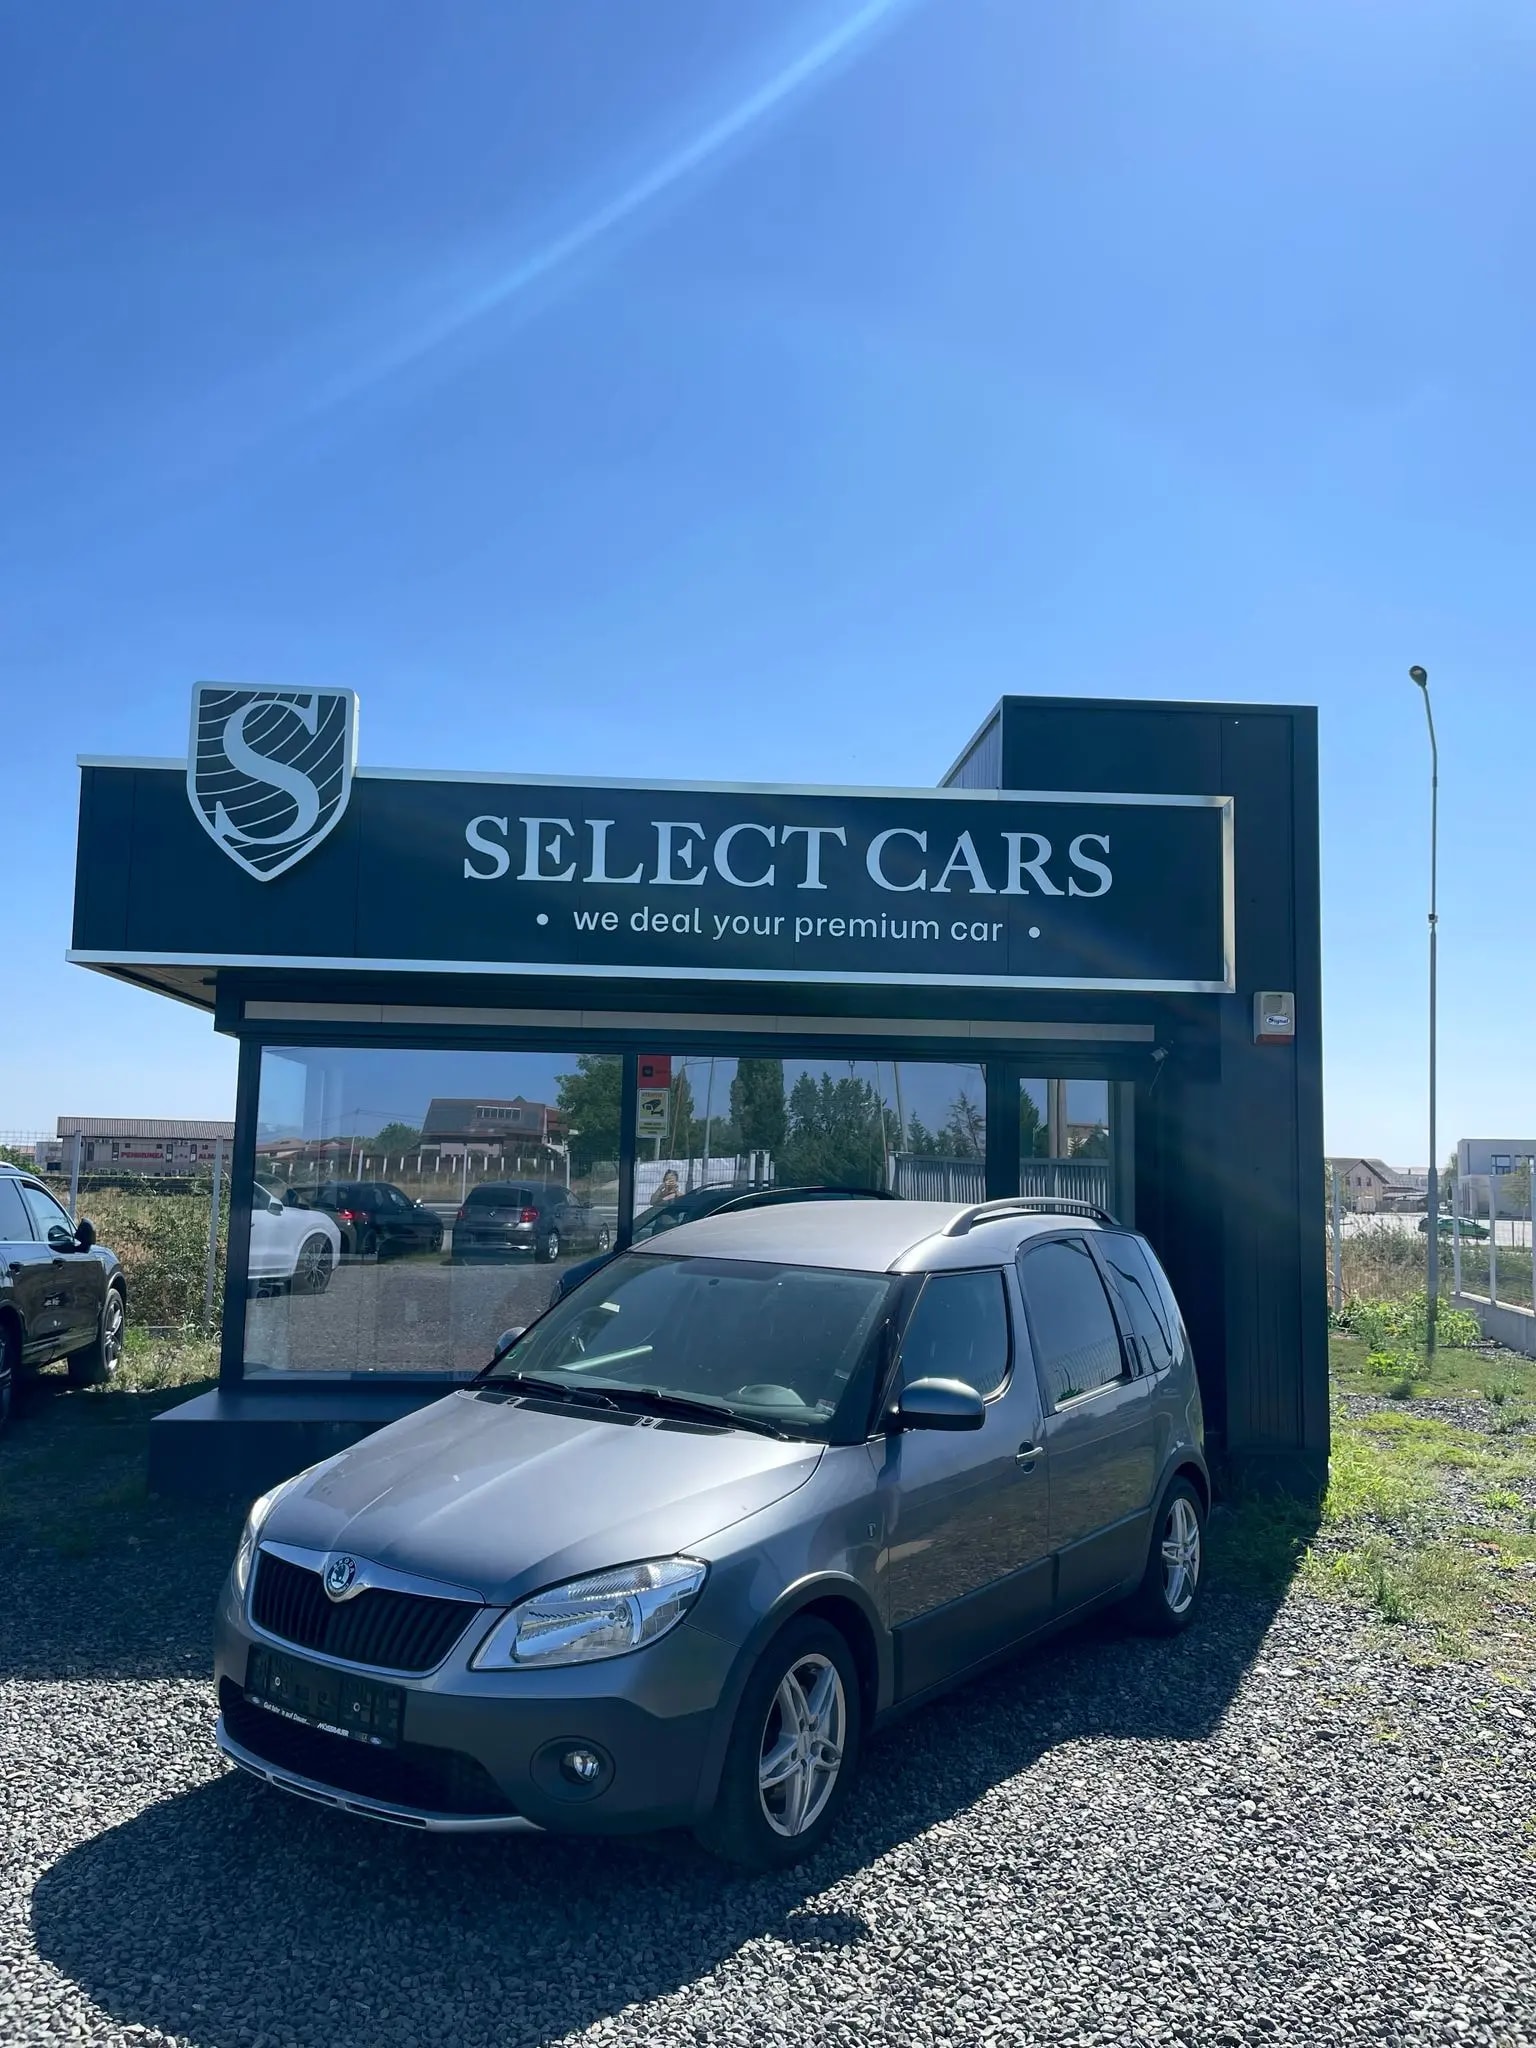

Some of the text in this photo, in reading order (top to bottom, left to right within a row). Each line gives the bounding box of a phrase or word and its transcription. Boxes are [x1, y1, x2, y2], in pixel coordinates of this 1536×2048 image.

[464, 815, 1113, 897] SELECT CARS
[573, 906, 1003, 942] we deal your premium car
